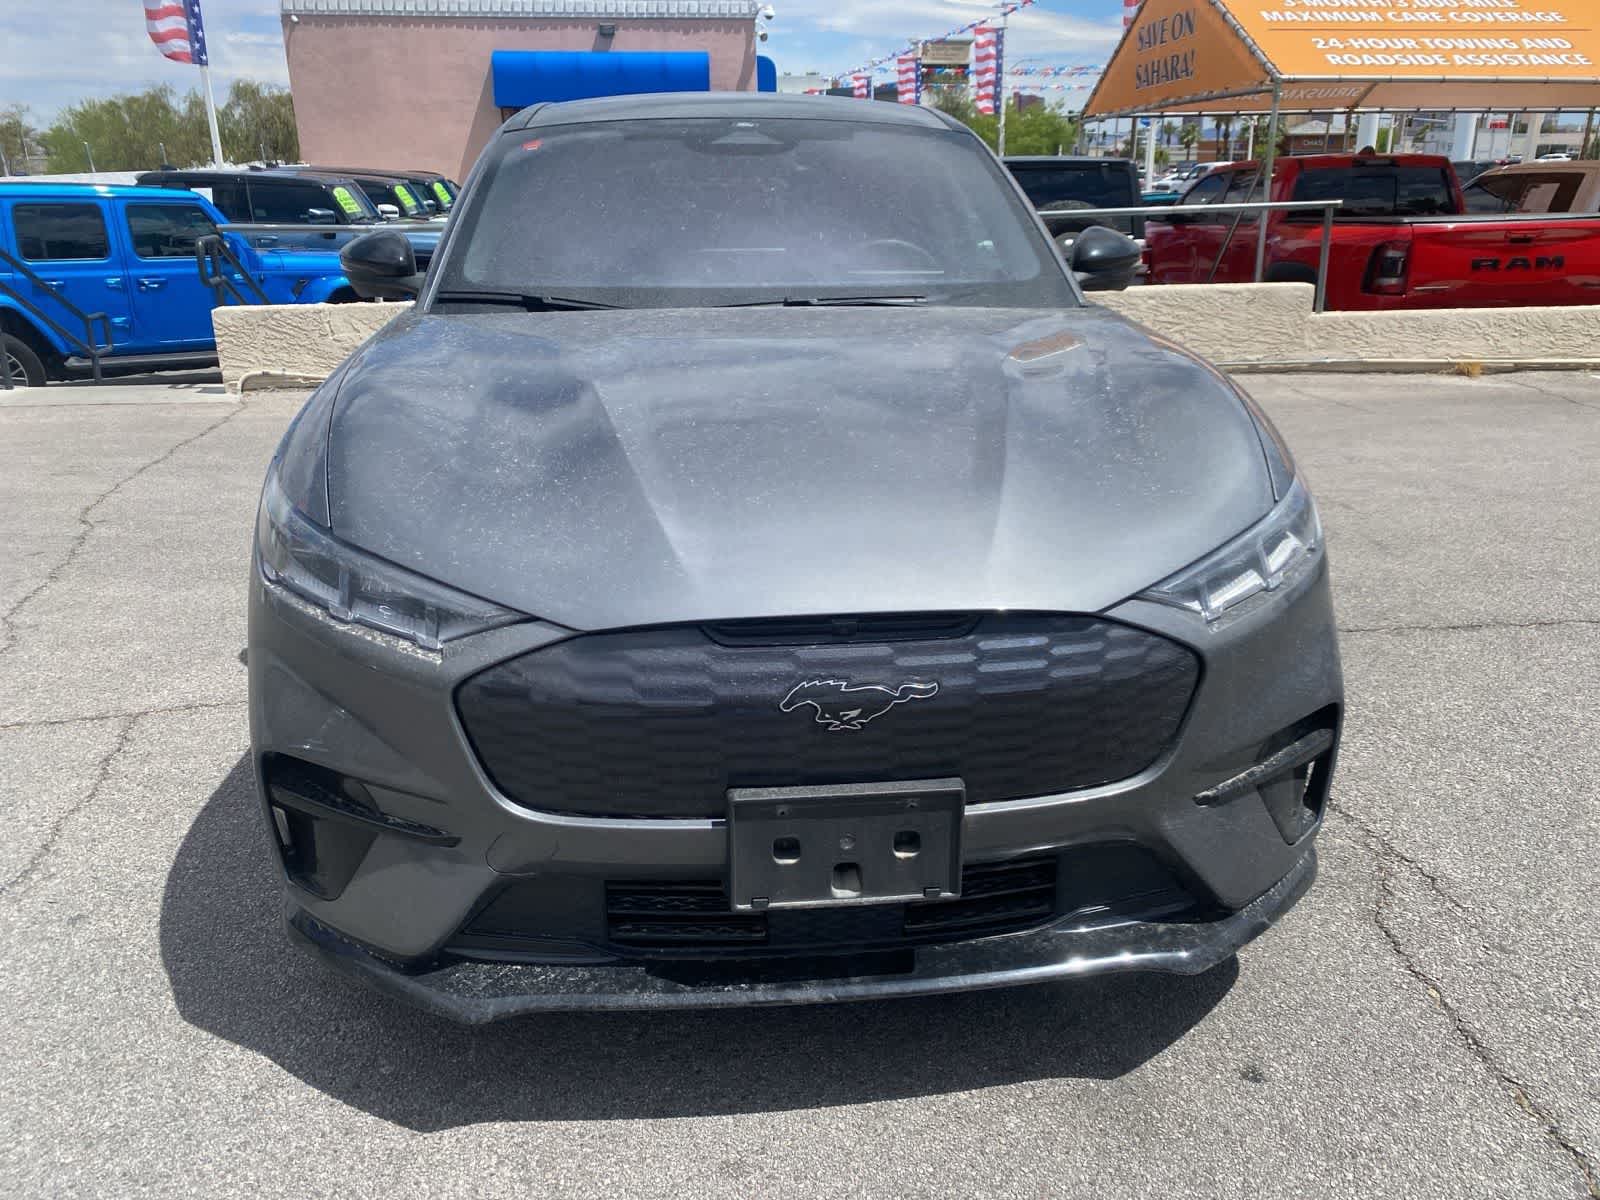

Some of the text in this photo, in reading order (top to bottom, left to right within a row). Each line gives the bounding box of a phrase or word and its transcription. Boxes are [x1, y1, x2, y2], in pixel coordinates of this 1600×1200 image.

[1260, 11, 1568, 22] MAXIMUM CARE COVERAGE
[1137, 8, 1196, 52] SAVE ON
[1312, 38, 1573, 49] 24-HOUR TOWING AND
[1325, 54, 1593, 65] ROADSIDE ASSISTANCE
[1135, 49, 1196, 90] SAHARA!
[1472, 256, 1565, 272] RAM
